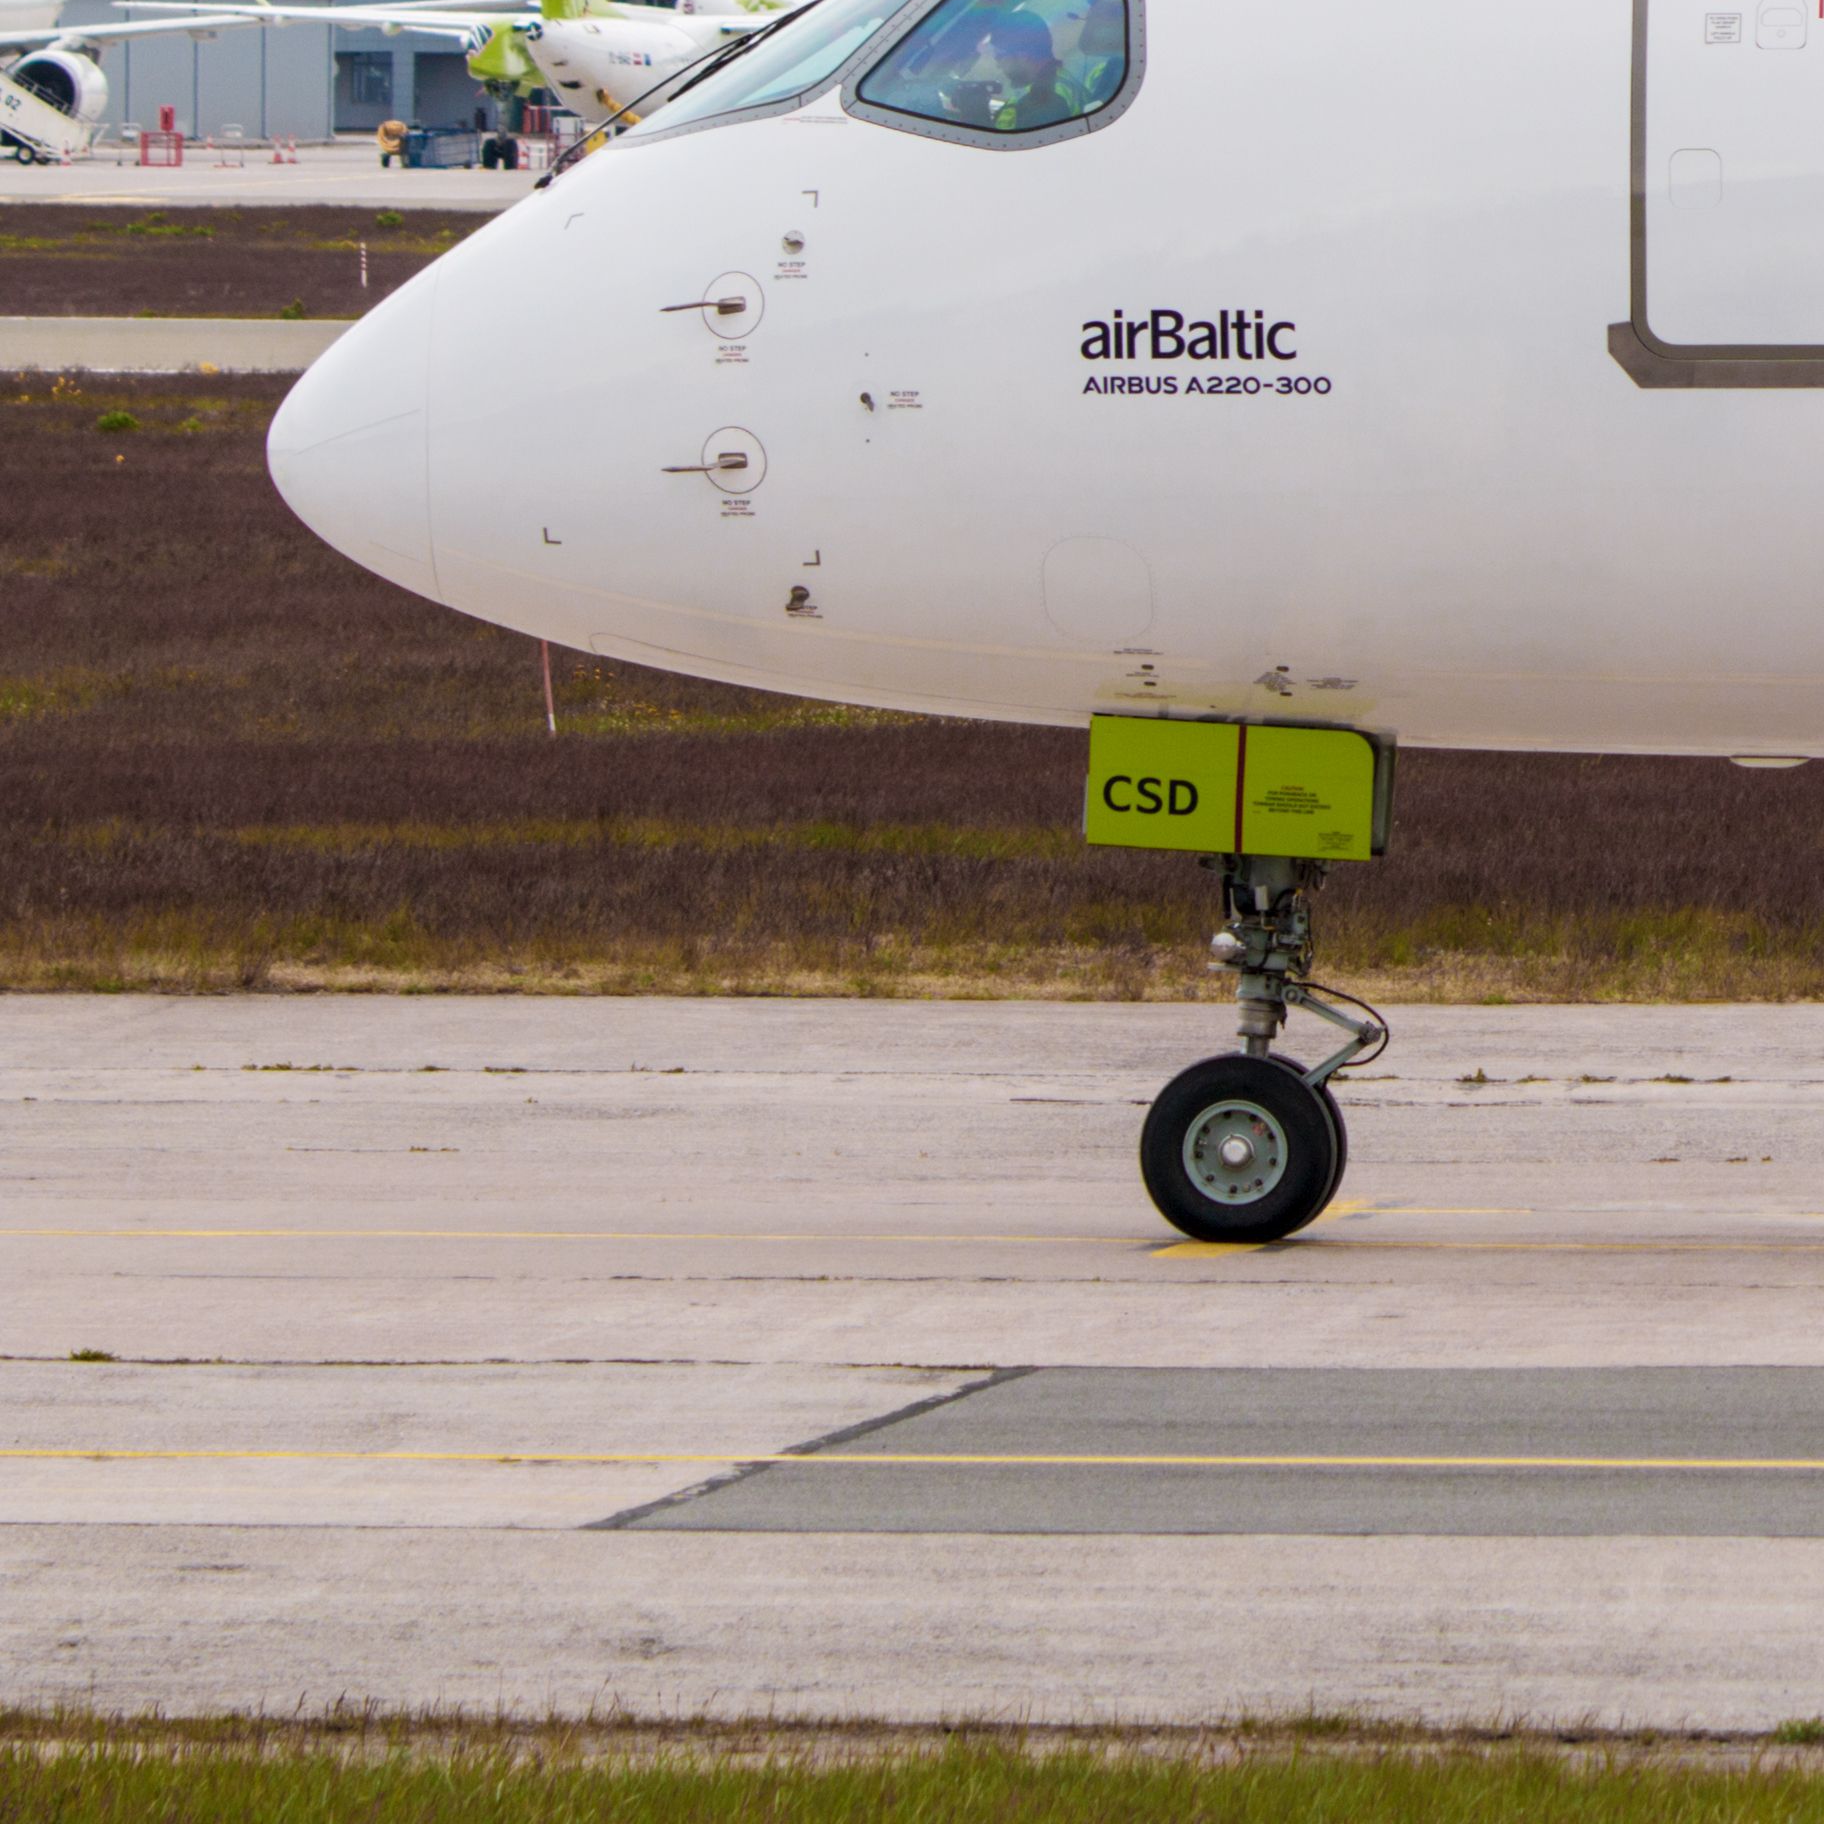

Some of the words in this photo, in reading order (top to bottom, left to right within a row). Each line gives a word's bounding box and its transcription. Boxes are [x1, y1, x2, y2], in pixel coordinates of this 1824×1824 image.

[1080, 310, 1297, 361] airBaltic
[1083, 376, 1178, 395] AIRBUS
[1185, 376, 1332, 395] A220-300
[1103, 775, 1200, 818] CSD
